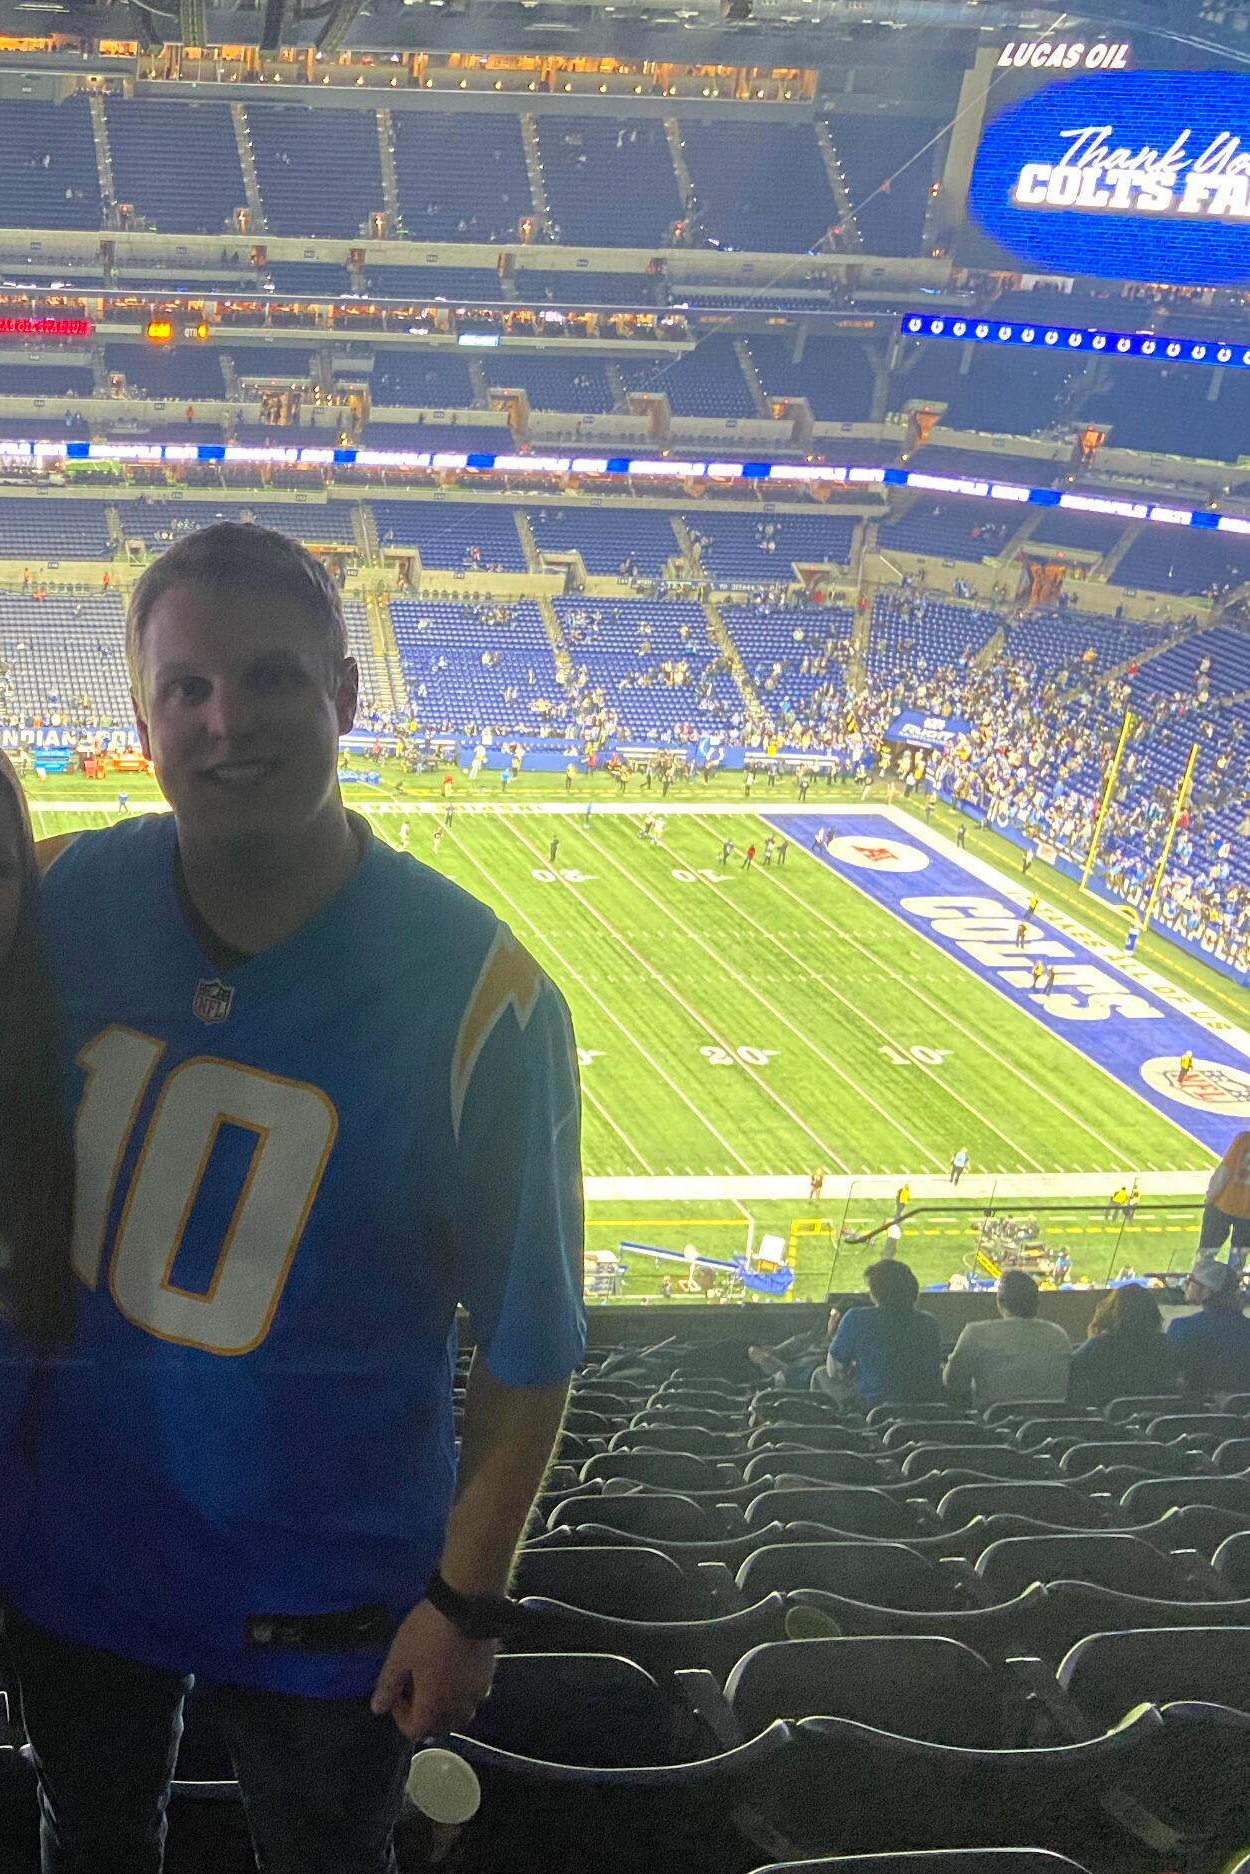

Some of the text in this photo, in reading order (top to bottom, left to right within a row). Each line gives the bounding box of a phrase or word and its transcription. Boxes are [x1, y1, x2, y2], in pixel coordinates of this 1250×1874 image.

[998, 43, 1129, 68] LUCAS OIL
[1060, 125, 1194, 173] Thank
[1016, 164, 1177, 211] COLTS
[900, 896, 1165, 1020] COLTS
[699, 1045, 769, 1066] 20
[878, 1045, 943, 1066] 10
[73, 1023, 339, 1356] 10
